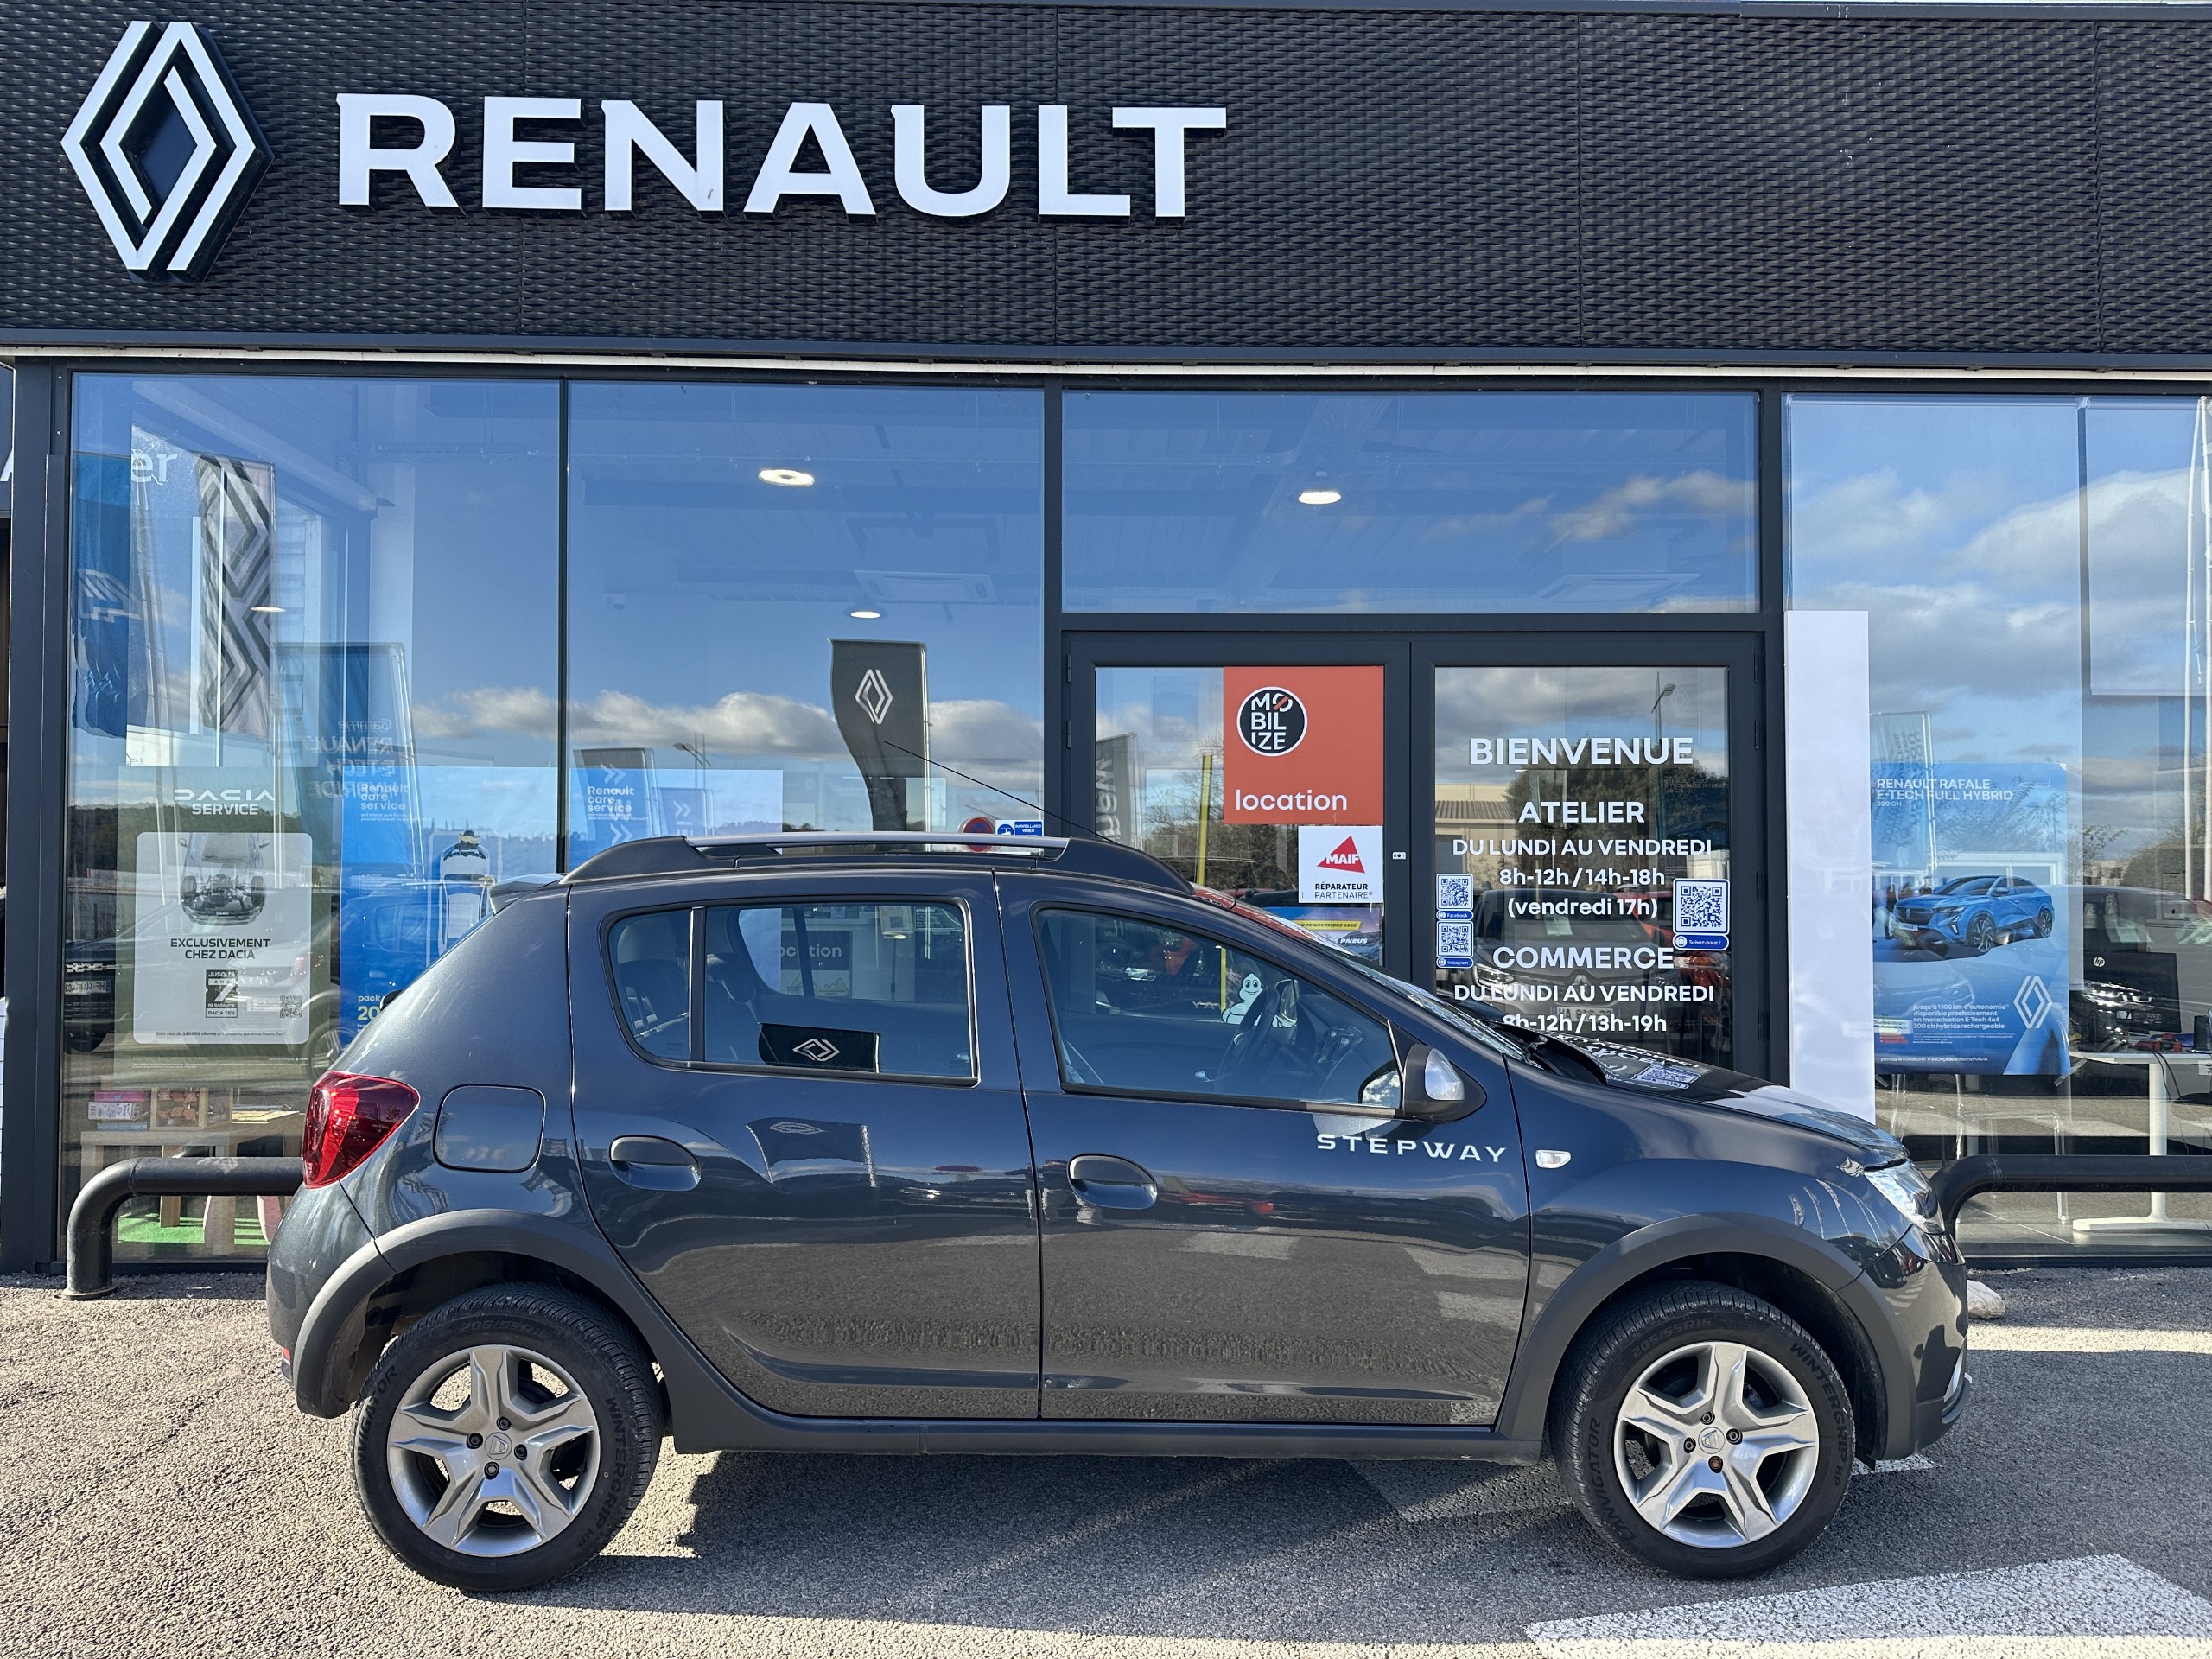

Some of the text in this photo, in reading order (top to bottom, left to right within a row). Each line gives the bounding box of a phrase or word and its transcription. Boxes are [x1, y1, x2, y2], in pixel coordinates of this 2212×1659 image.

[336, 93, 1226, 218] RENAULT
[1471, 737, 1694, 765] BIENVENUE
[361, 783, 409, 793] Renault
[588, 785, 634, 795] Renault
[1878, 779, 1990, 790] RENAULT RAFALE
[174, 789, 276, 801] DACIA
[588, 795, 614, 804] care
[1236, 790, 1347, 810] location
[1877, 790, 2013, 800] E-TECH FULL HYBRID
[192, 804, 259, 815] SERVICE
[361, 800, 405, 810] service
[588, 804, 632, 812] service
[1518, 801, 1645, 823] ATELIER
[1452, 839, 1712, 855] DU LUNDI AU VENDREDI
[1325, 854, 1359, 864] MAIF
[1499, 868, 1569, 886] 8h-12h
[1587, 868, 1665, 886] 14h-18h
[1315, 881, 1368, 890] RÉPARATEUR
[1508, 898, 1658, 918] (vendredi 17h)
[170, 938, 271, 948] EXCLUSIVEMENT
[185, 950, 256, 960] CHEZ DACIA
[1492, 946, 1675, 969] COMMERCE
[1454, 985, 1714, 1001] DU LUNDI AU VENDREDI
[1590, 1014, 1667, 1032] 13h-19h
[1317, 1134, 1507, 1163] STEPWAY
